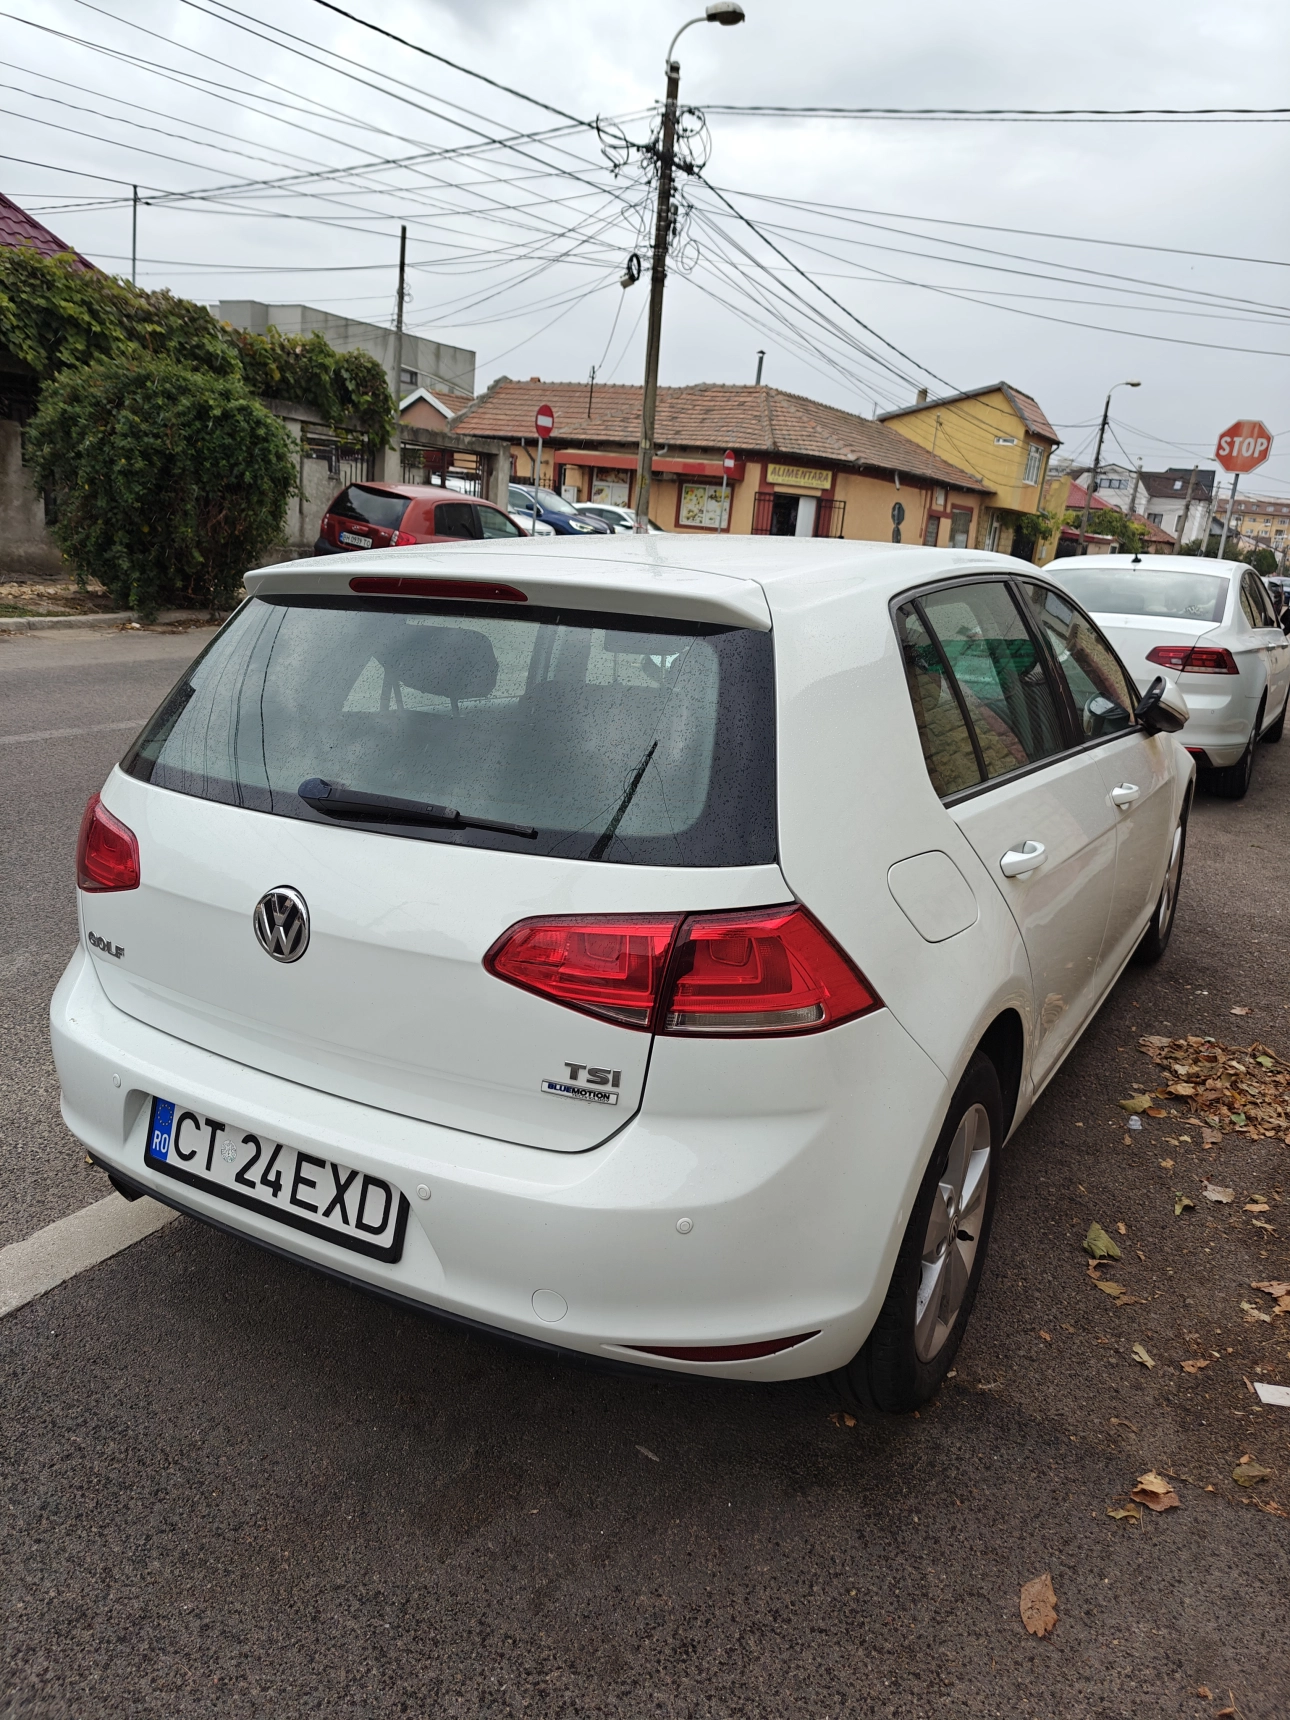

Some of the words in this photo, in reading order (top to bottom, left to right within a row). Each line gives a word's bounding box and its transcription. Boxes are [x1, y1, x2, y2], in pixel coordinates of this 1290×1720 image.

[1219, 437, 1268, 458] STOP
[771, 466, 829, 483] ALIMENTARA
[88, 931, 125, 960] GOLF
[564, 1060, 622, 1088] TSI
[547, 1082, 611, 1100] BLUEMOTION
[152, 1130, 169, 1153] RO
[174, 1111, 225, 1172] CT
